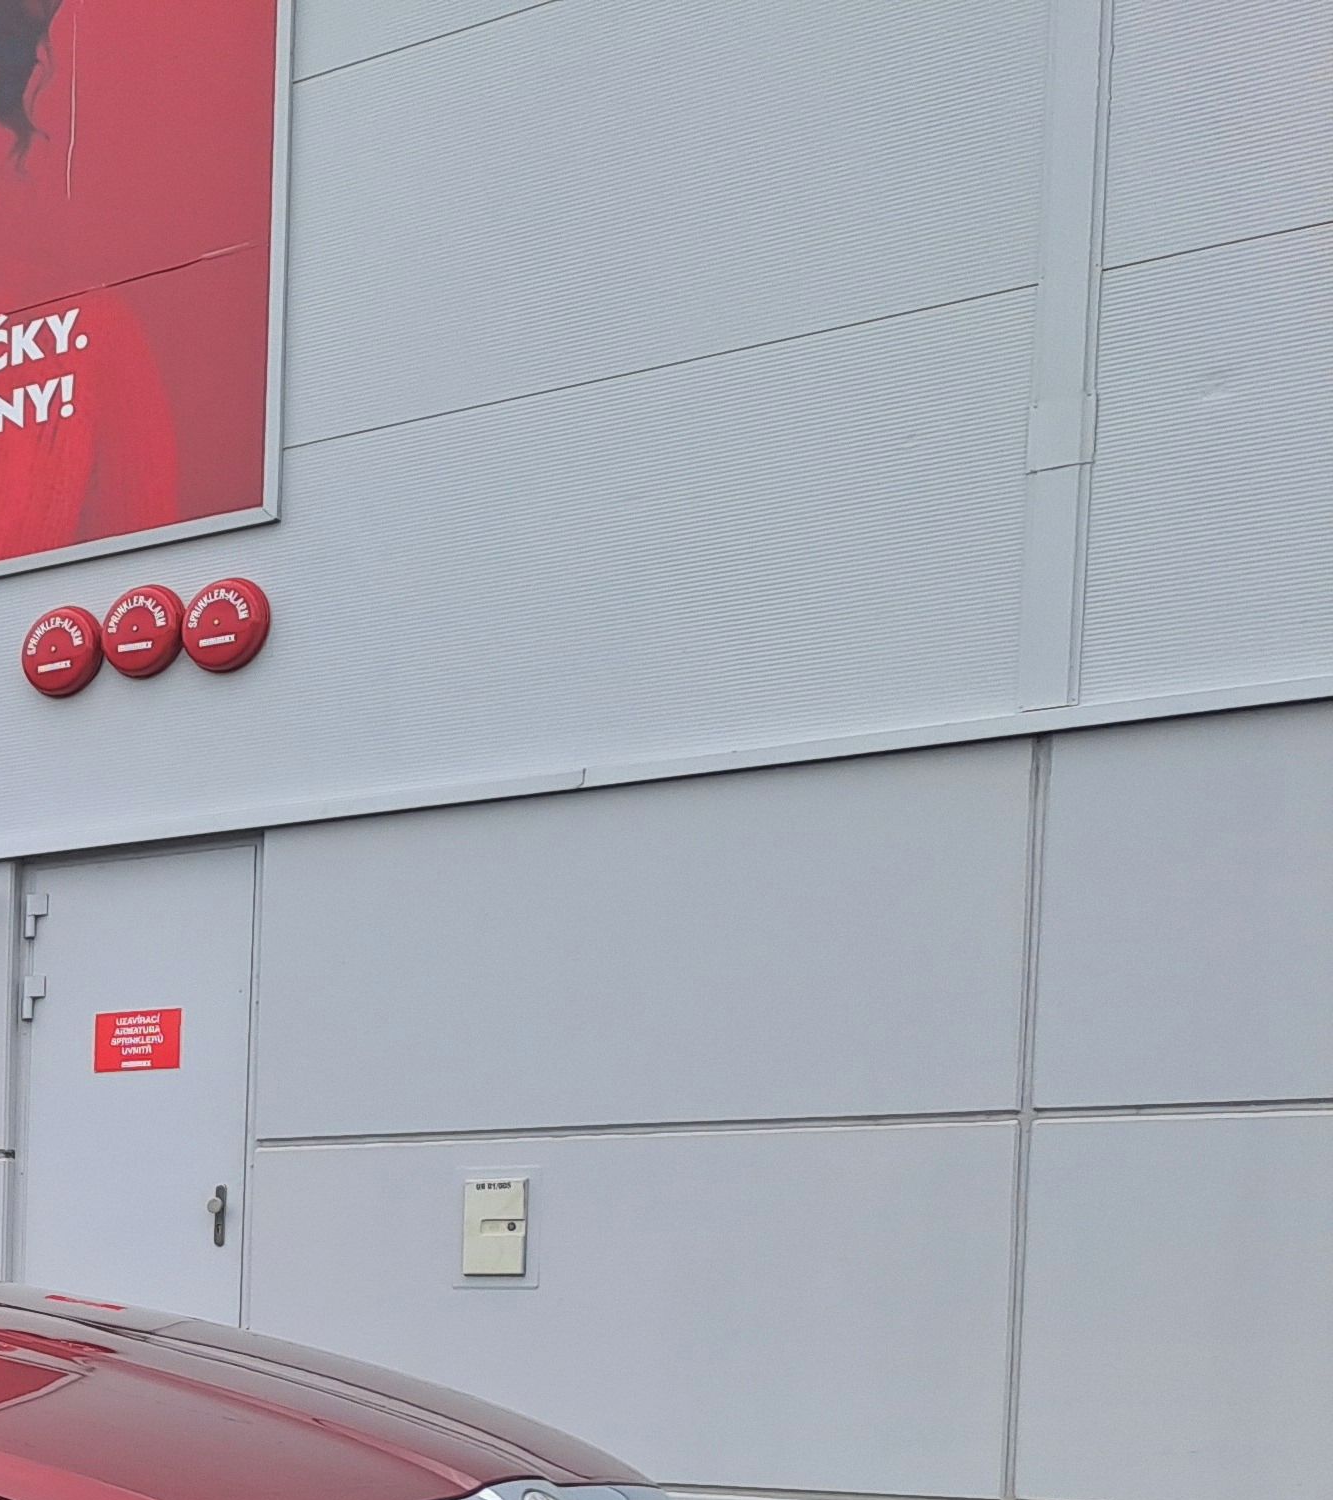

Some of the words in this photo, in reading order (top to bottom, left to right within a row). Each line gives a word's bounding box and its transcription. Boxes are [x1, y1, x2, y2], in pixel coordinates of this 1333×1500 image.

[107, 595, 167, 634] SPRINKLER-ALARM
[188, 588, 250, 629] SPRINKLER-ALARM
[27, 616, 83, 655] SPRINKLER-ALARM
